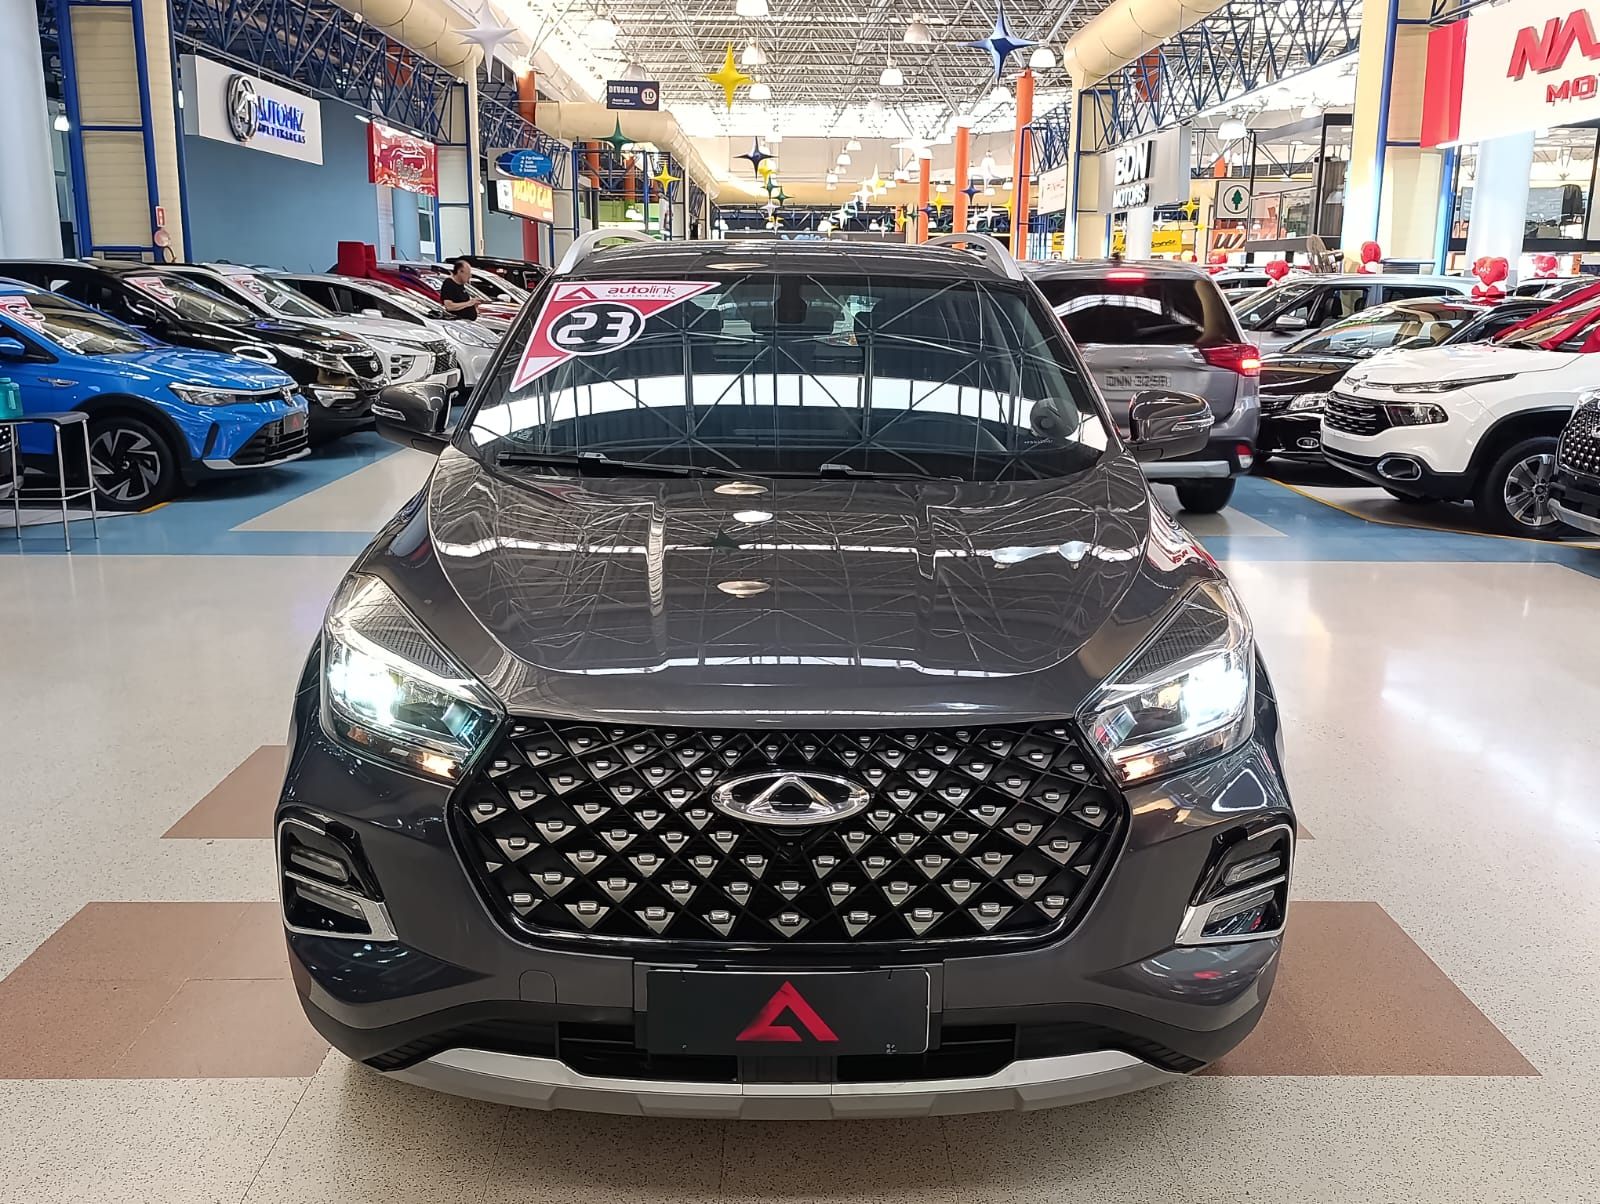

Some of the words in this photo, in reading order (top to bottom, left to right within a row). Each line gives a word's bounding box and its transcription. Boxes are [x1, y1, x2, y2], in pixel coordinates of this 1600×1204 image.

[1506, 8, 1600, 80] NA
[1546, 73, 1600, 104] MO
[1114, 140, 1152, 186] BDN
[1113, 183, 1149, 208] MOTORS
[608, 286, 676, 294] autolink
[556, 312, 634, 344] 23
